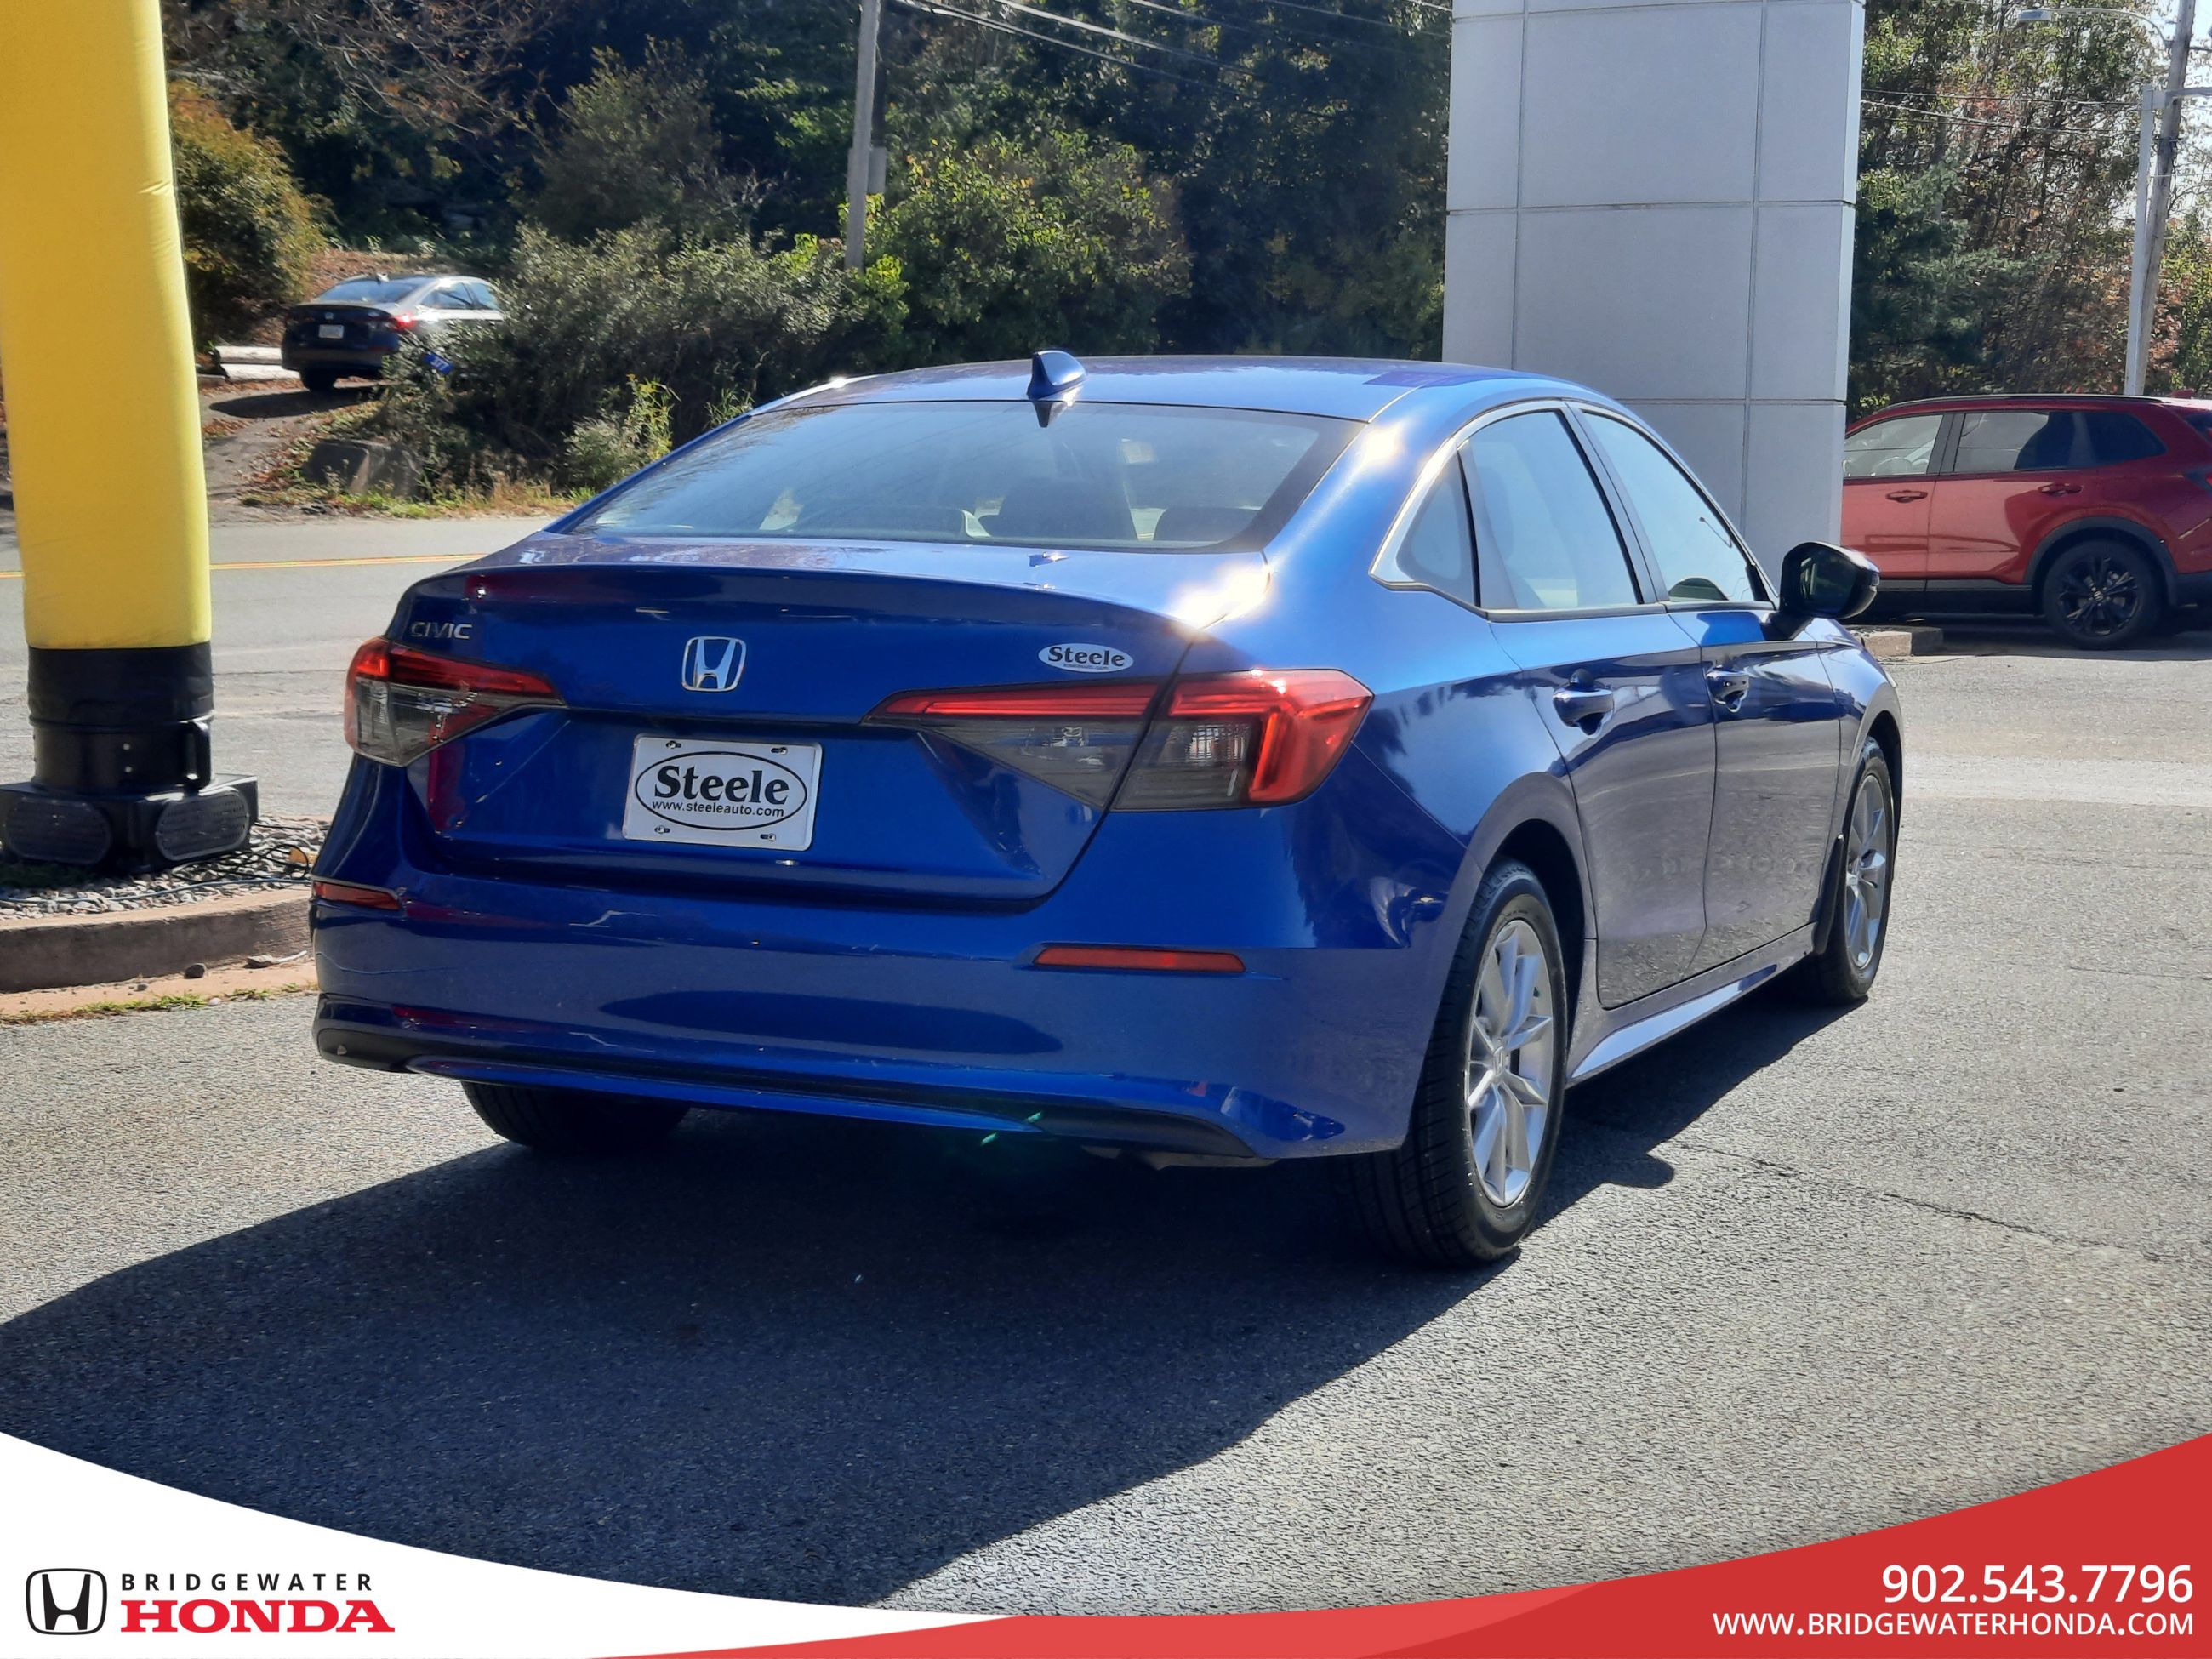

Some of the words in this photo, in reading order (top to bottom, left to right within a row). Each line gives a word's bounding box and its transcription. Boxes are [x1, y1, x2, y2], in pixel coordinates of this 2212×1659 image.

[411, 621, 473, 639] CIVIC
[1047, 646, 1126, 667] Steele
[654, 765, 790, 805] Steele
[652, 800, 784, 818] www.steeleauto.com
